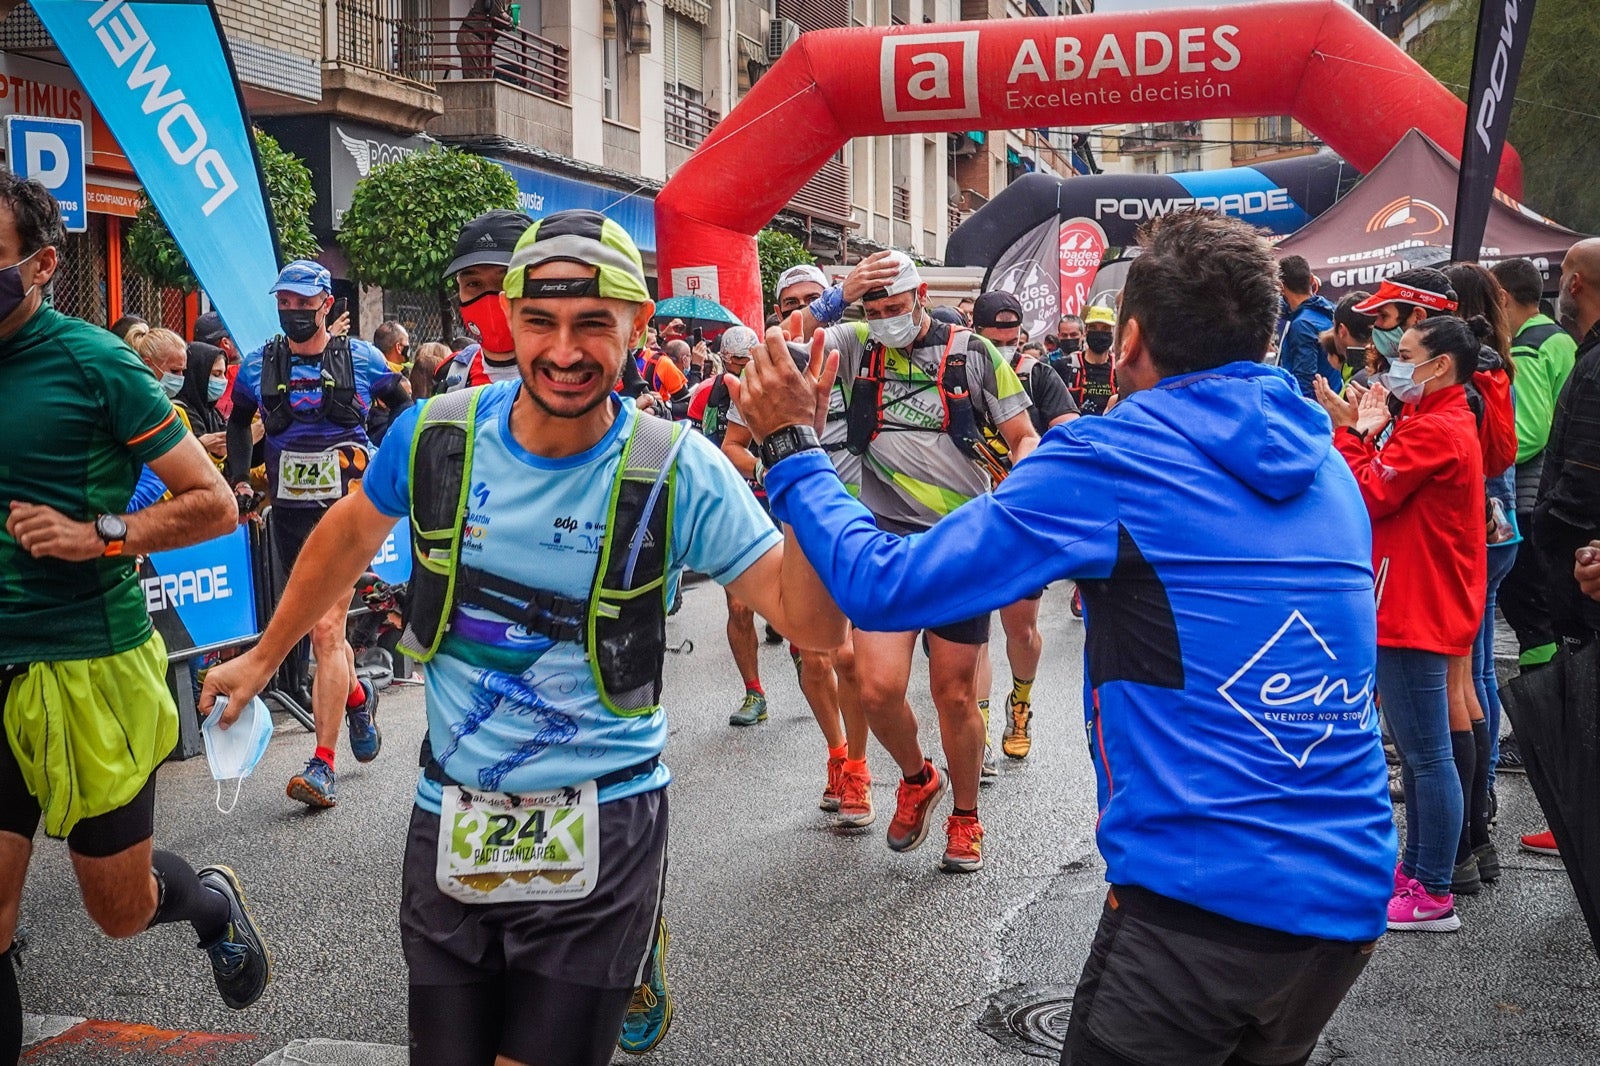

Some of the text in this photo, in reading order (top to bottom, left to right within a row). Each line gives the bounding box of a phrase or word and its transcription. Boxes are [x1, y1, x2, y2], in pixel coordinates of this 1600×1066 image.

[1006, 25, 1241, 84] ABADES
[1006, 78, 1231, 110] Excelente decisión
[518, 191, 544, 212] ovistar
[1066, 258, 1101, 267] stone
[294, 462, 320, 479] 74
[553, 515, 578, 533] edp
[140, 565, 229, 613] ERADE
[1263, 712, 1315, 721] EVENTOS
[1342, 711, 1362, 720] STOP
[485, 809, 548, 847] 24
[473, 844, 556, 866] PACO CAÑIZARES
